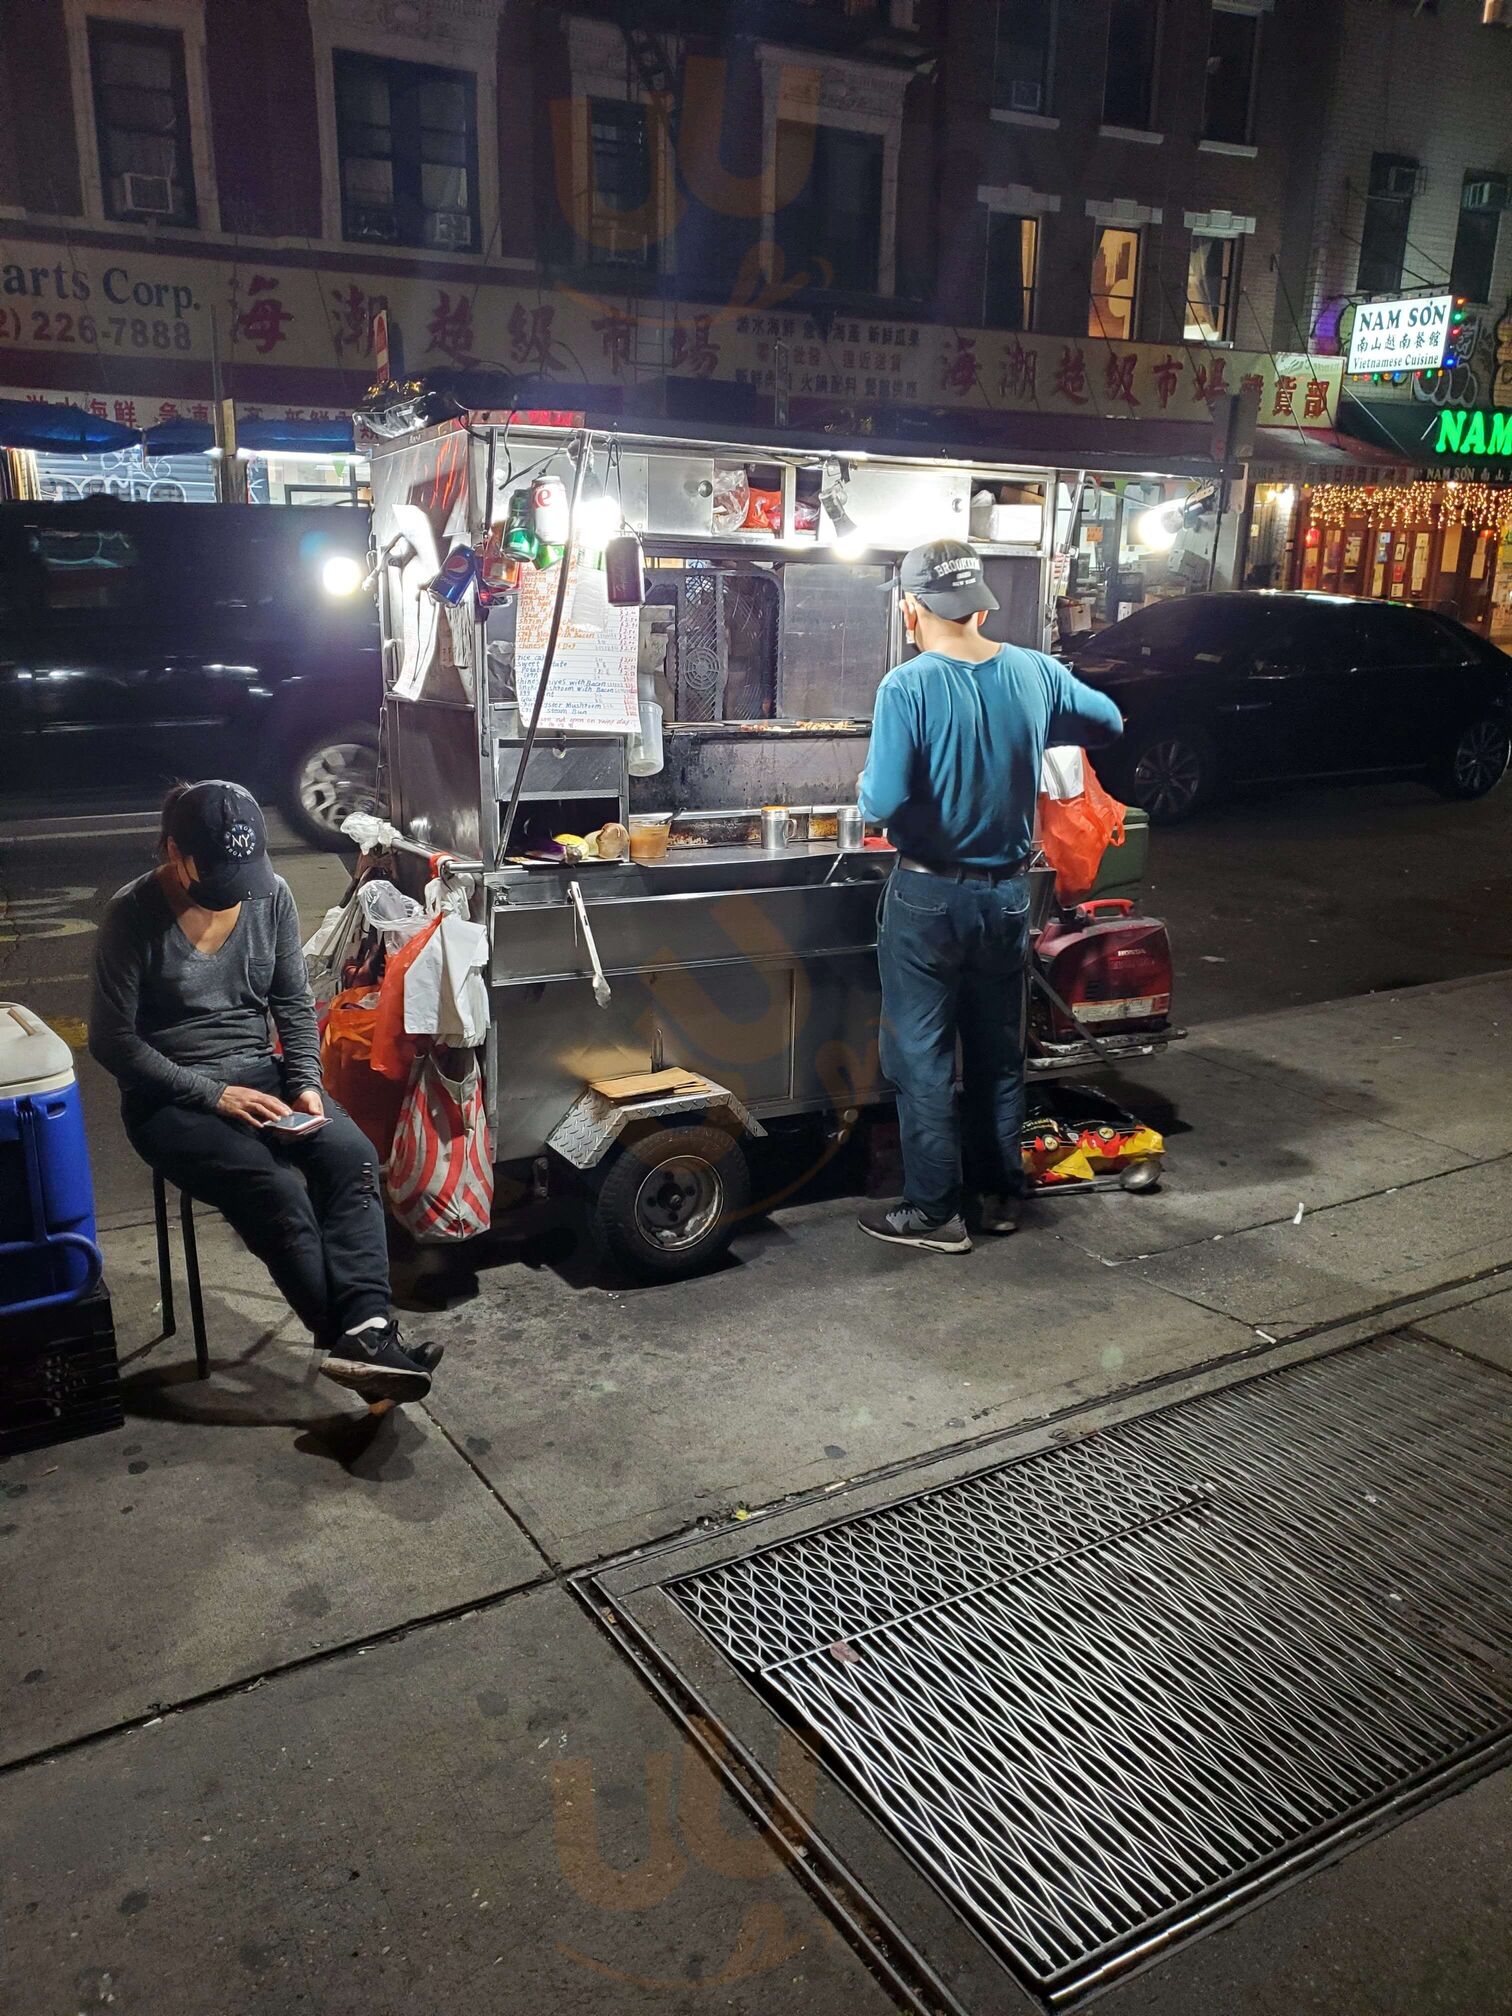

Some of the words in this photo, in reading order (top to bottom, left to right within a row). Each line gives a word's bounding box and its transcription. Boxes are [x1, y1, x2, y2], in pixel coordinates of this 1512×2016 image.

[102, 266, 200, 319] Corp.
[31, 309, 193, 352] 226-7888
[1359, 309, 1402, 332] NAM
[1357, 330, 1441, 354] 南山越南餐館
[1353, 355, 1402, 371] Vietnamese
[1404, 353, 1439, 367] Cuisine
[1426, 467, 1451, 481] NAM
[933, 557, 981, 578] BROOKLYN
[231, 833, 250, 848] NY
